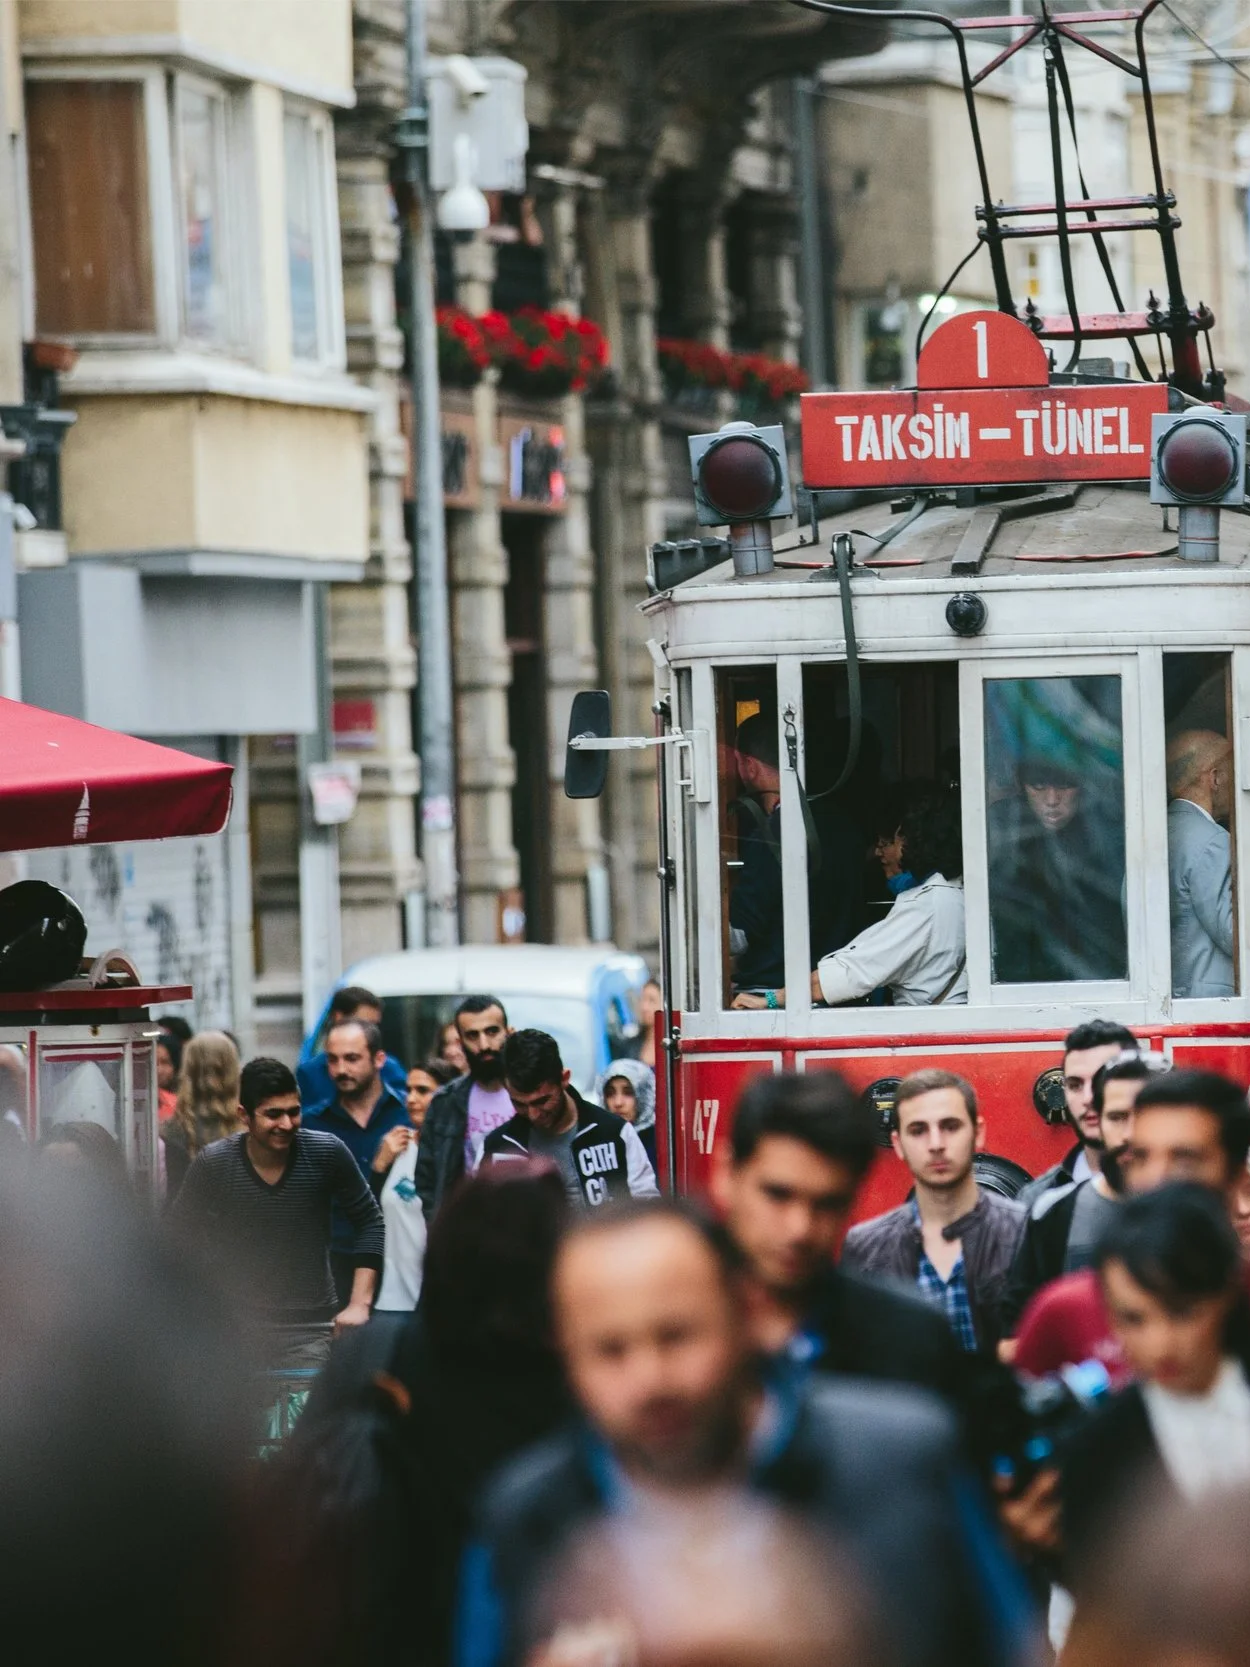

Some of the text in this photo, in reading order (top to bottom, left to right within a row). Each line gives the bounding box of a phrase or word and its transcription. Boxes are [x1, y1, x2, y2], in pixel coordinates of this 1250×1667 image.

[972, 320, 989, 379] 1
[834, 403, 970, 462] TAKSİM
[1016, 400, 1145, 456] TÜNEL
[692, 1099, 720, 1155] 47
